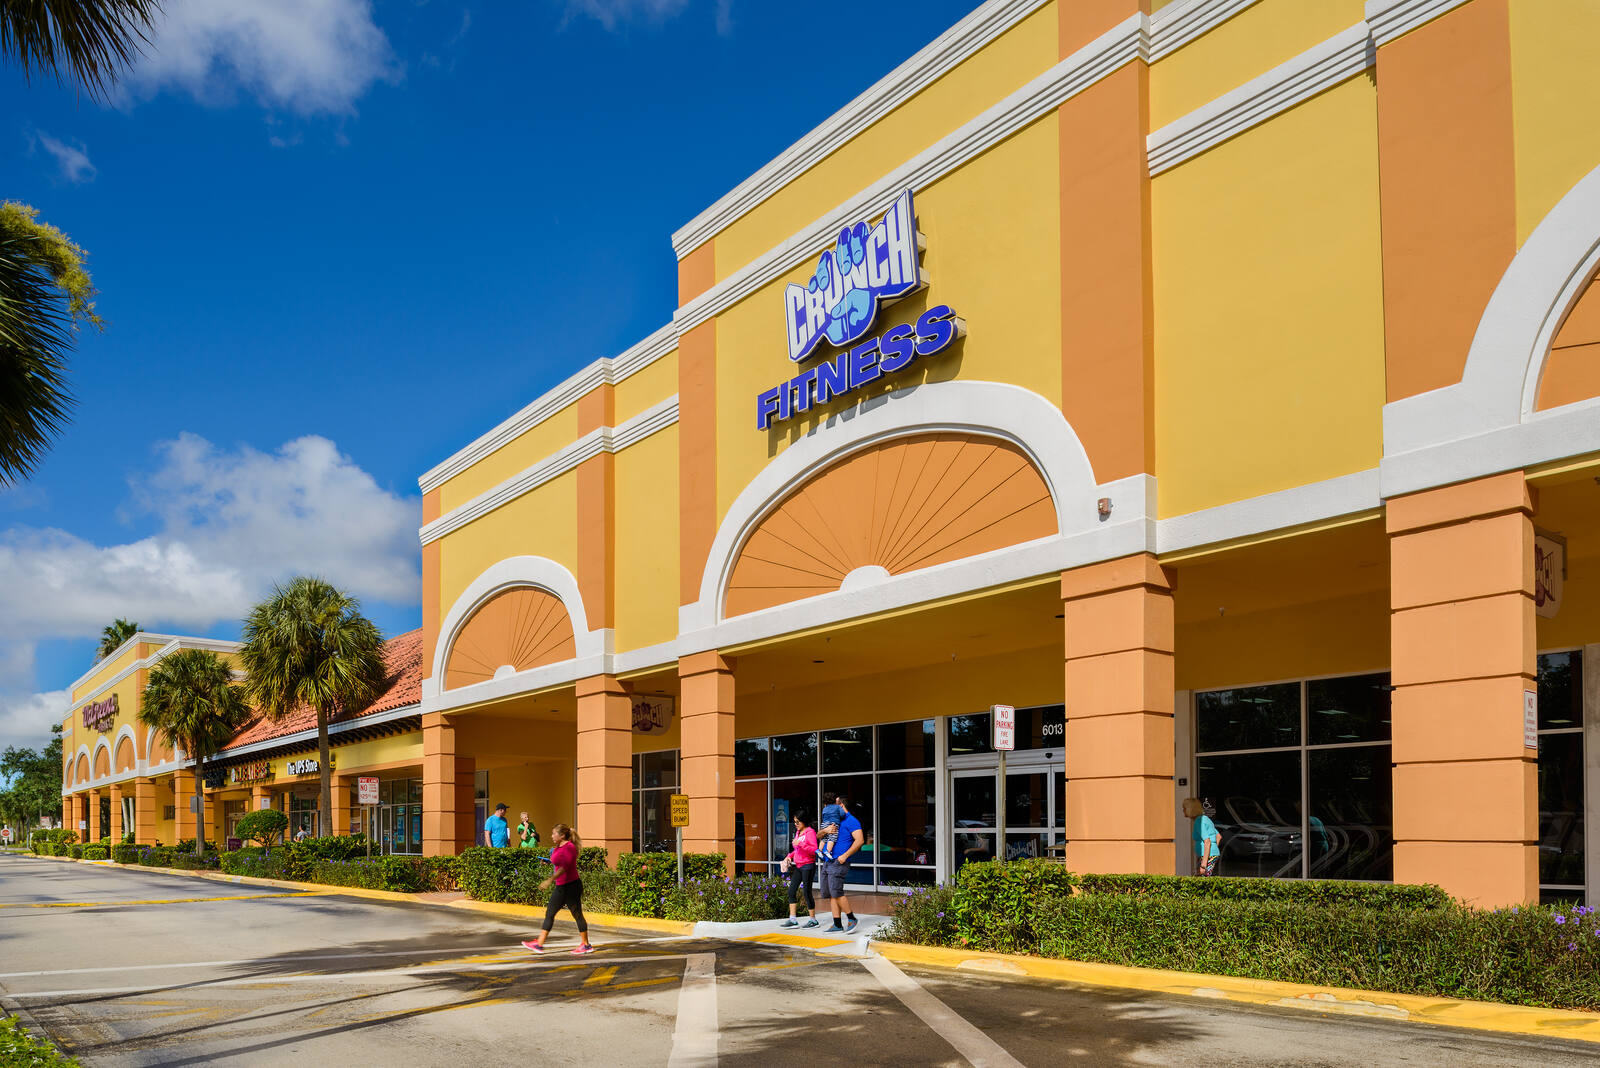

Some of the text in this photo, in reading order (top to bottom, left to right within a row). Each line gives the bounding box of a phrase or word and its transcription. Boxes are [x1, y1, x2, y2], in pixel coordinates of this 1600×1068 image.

[786, 190, 915, 358] CRUNCH
[757, 305, 958, 431] FITNESS
[1000, 710, 1009, 719] NO
[995, 720, 1014, 730] PARKING
[1042, 723, 1063, 736] 6013
[296, 760, 305, 774] UPS
[305, 759, 318, 773] Store
[673, 815, 688, 823] BUMP
